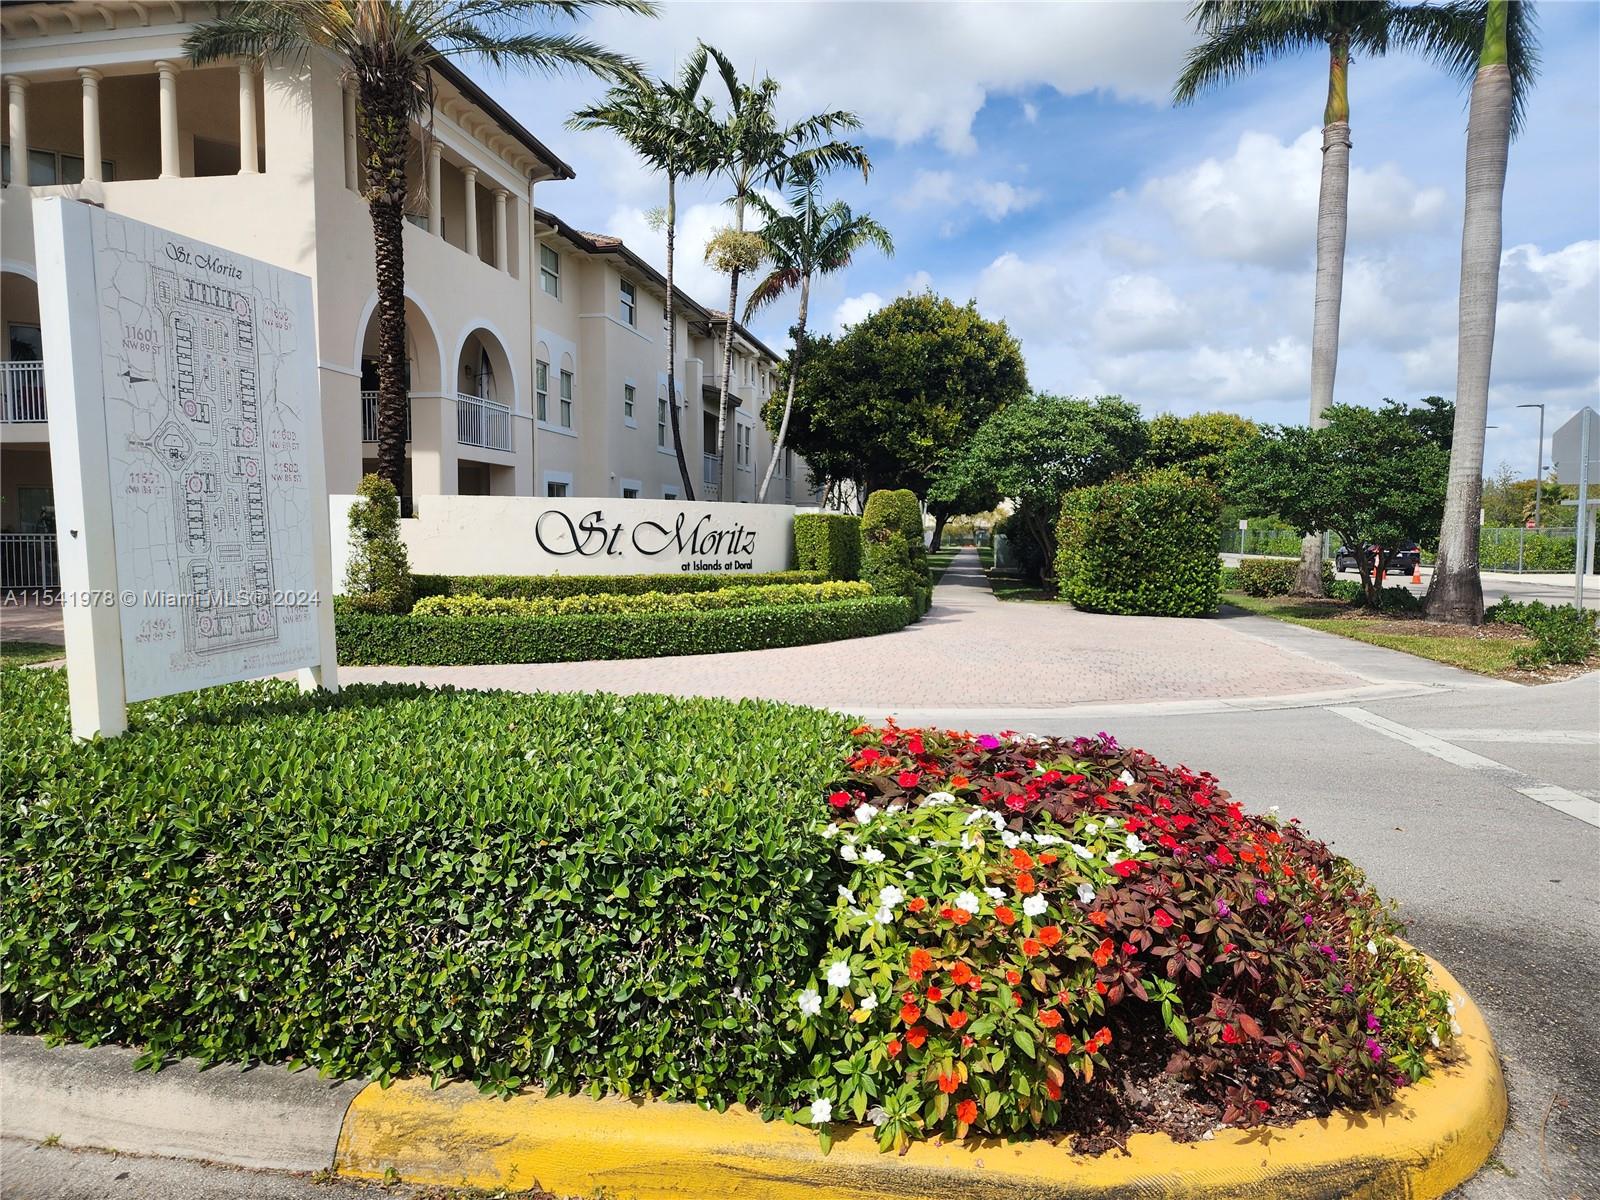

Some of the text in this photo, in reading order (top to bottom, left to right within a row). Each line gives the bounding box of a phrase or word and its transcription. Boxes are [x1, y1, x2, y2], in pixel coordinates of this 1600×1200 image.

[166, 242, 242, 280] St. Moritz
[125, 325, 158, 343] 11601
[122, 338, 160, 354] NW 89 ST
[536, 510, 756, 556] St. Moritz
[681, 560, 752, 571] at Islands at Doral
